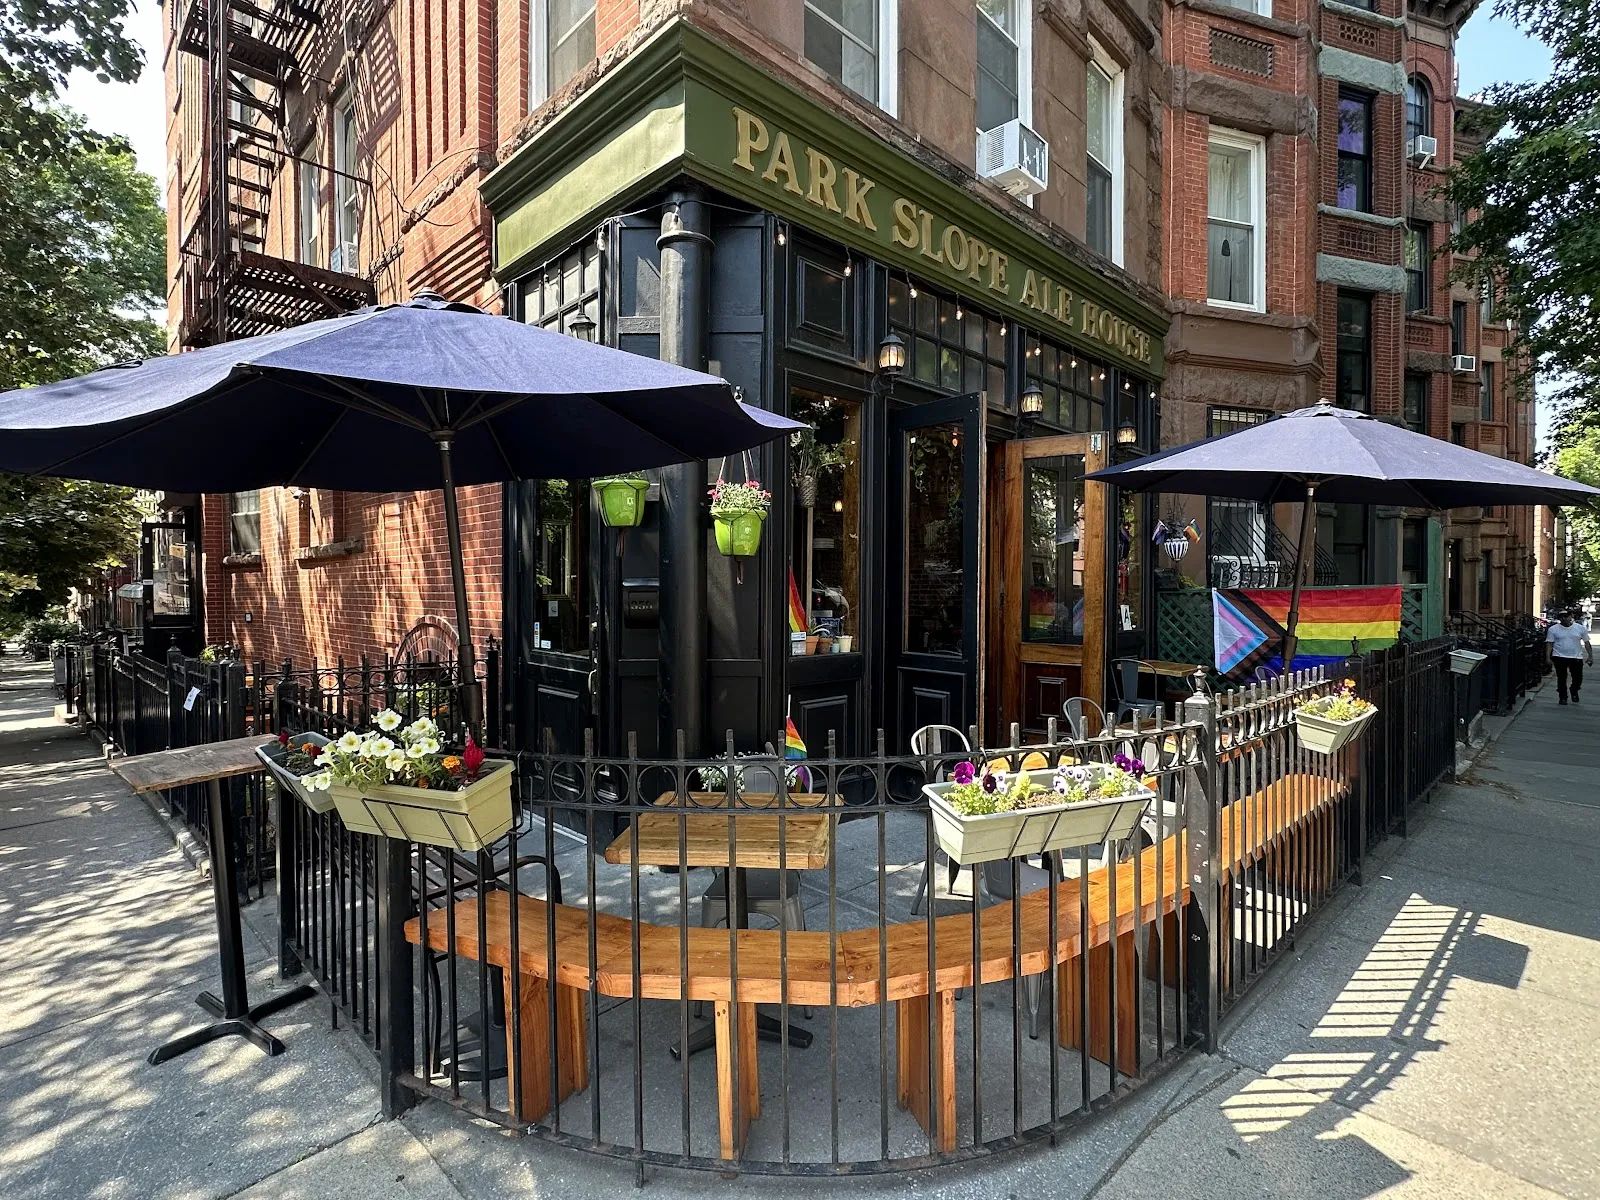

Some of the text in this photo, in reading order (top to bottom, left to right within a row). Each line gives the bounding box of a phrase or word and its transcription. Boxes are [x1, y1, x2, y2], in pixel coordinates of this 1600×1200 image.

[732, 106, 1151, 365] PARK SLOPE ALE HOUSE
[1124, 608, 1131, 624] A
